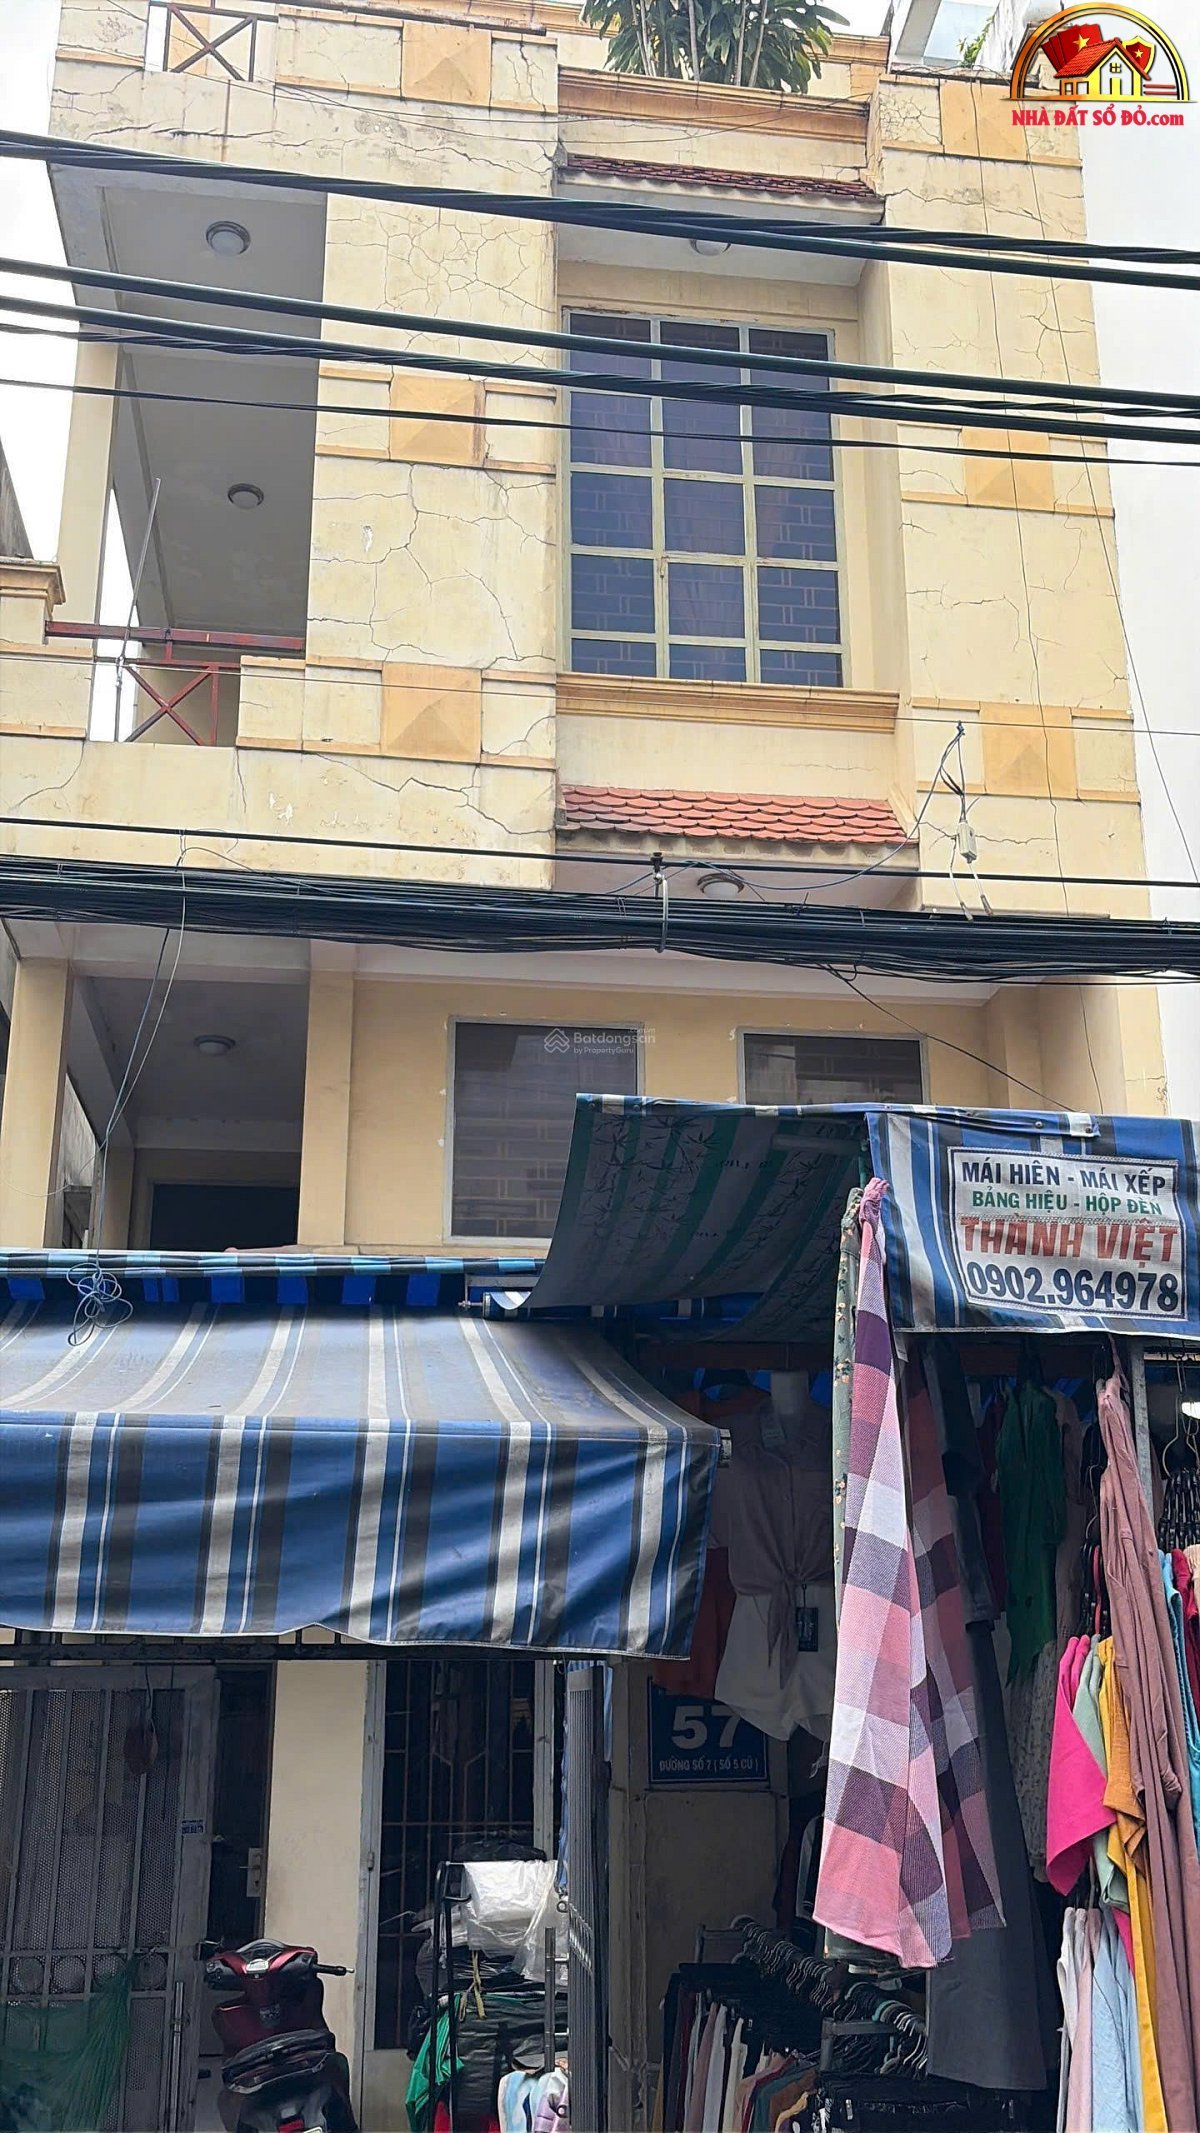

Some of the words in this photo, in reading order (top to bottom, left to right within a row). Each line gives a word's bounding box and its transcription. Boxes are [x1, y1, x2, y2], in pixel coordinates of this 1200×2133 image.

[962, 1156, 1001, 1185] MÁI
[1010, 1160, 1060, 1186] HIÊN
[1082, 1165, 1119, 1192] MÁI
[1126, 1168, 1166, 1197] XẾP
[972, 1186, 1020, 1209] BẢNG
[1026, 1190, 1067, 1214] HIỆU
[1086, 1193, 1121, 1216] HỘP
[1127, 1198, 1163, 1216] ĐÈN
[1096, 1218, 1178, 1268] VIỆT
[966, 1261, 1179, 1312] 0902.964978
[671, 1705, 741, 1750] 57
